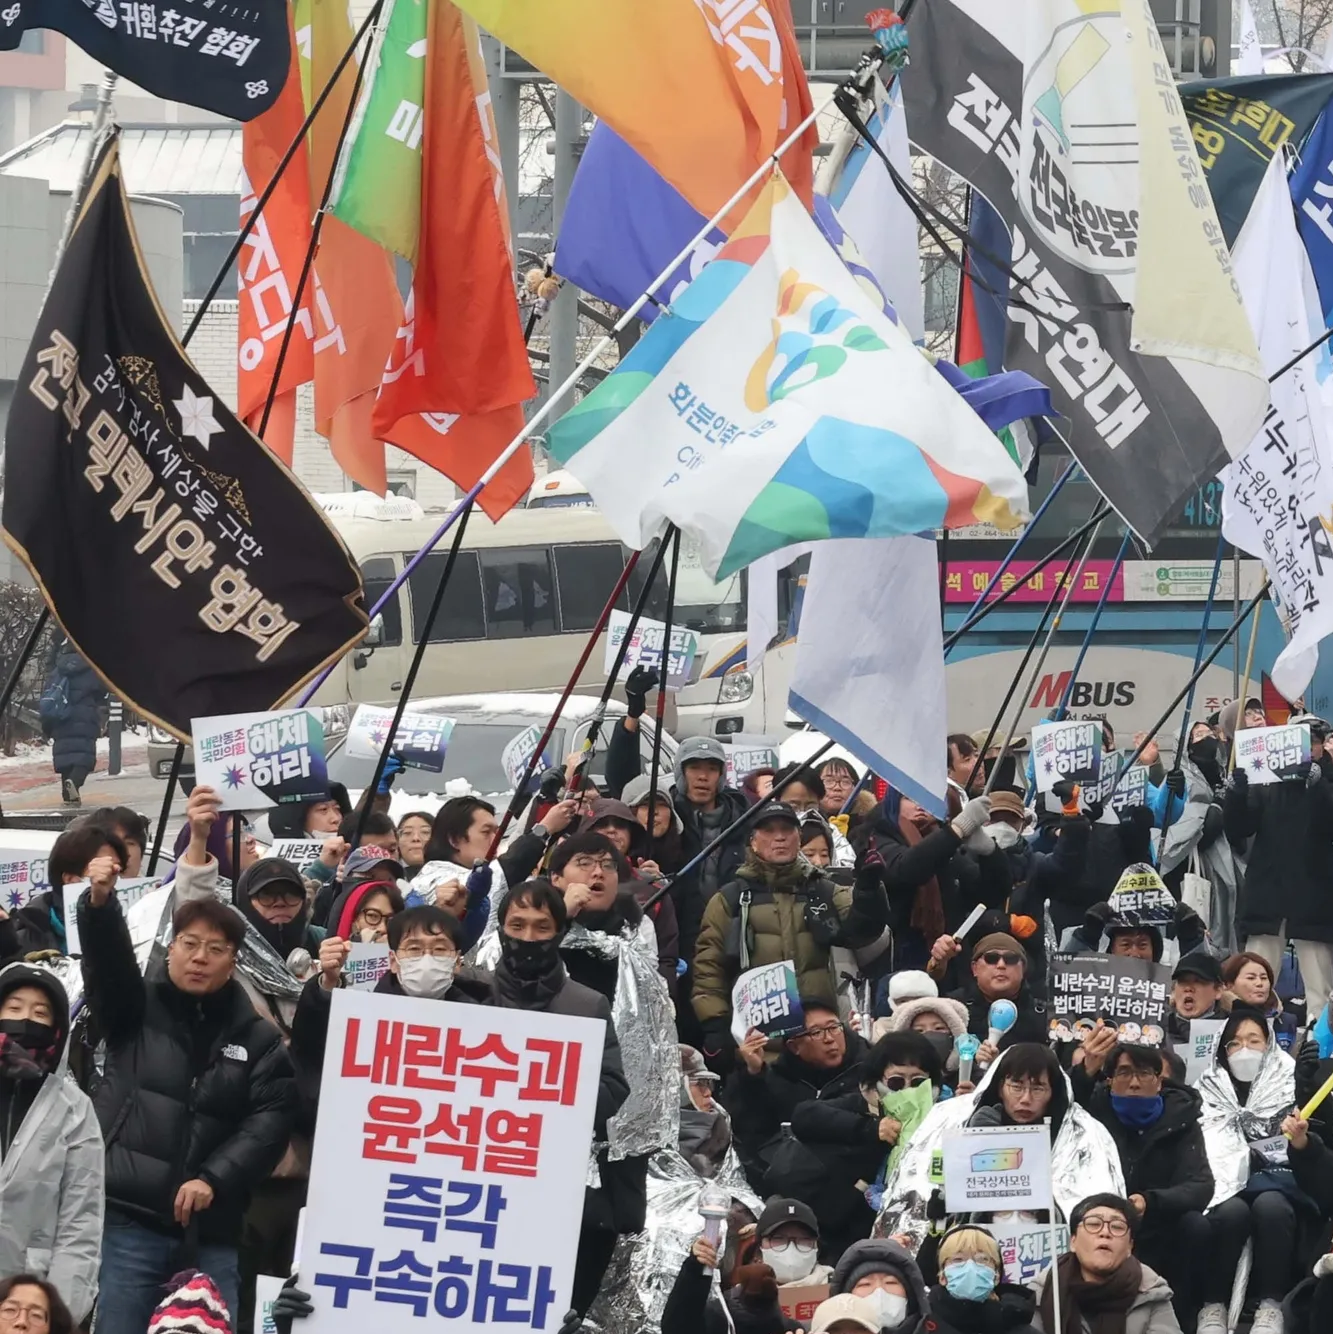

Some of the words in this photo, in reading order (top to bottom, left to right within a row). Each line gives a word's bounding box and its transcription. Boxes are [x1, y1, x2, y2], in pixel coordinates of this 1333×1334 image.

[200, 26, 260, 67] 협회
[84, 409, 218, 590] 밀레시안
[198, 563, 301, 664] 협회
[217, 512, 264, 565] 구한
[1029, 674, 1135, 708] MBUS
[200, 729, 245, 751] 내란동조
[248, 710, 309, 753] 해체
[201, 741, 246, 765] 국민의힘
[250, 750, 312, 788] 하라
[1054, 973, 1115, 993] 내란수괴
[1053, 995, 1096, 1014] 법대로
[1099, 998, 1164, 1021] 처단하라
[340, 1018, 583, 1106] 내란수괴
[362, 1096, 544, 1177] 윤석열
[966, 1173, 1031, 1188] 전국상자모임
[382, 1174, 507, 1250] 즉각
[314, 1243, 556, 1330] 구속하라
